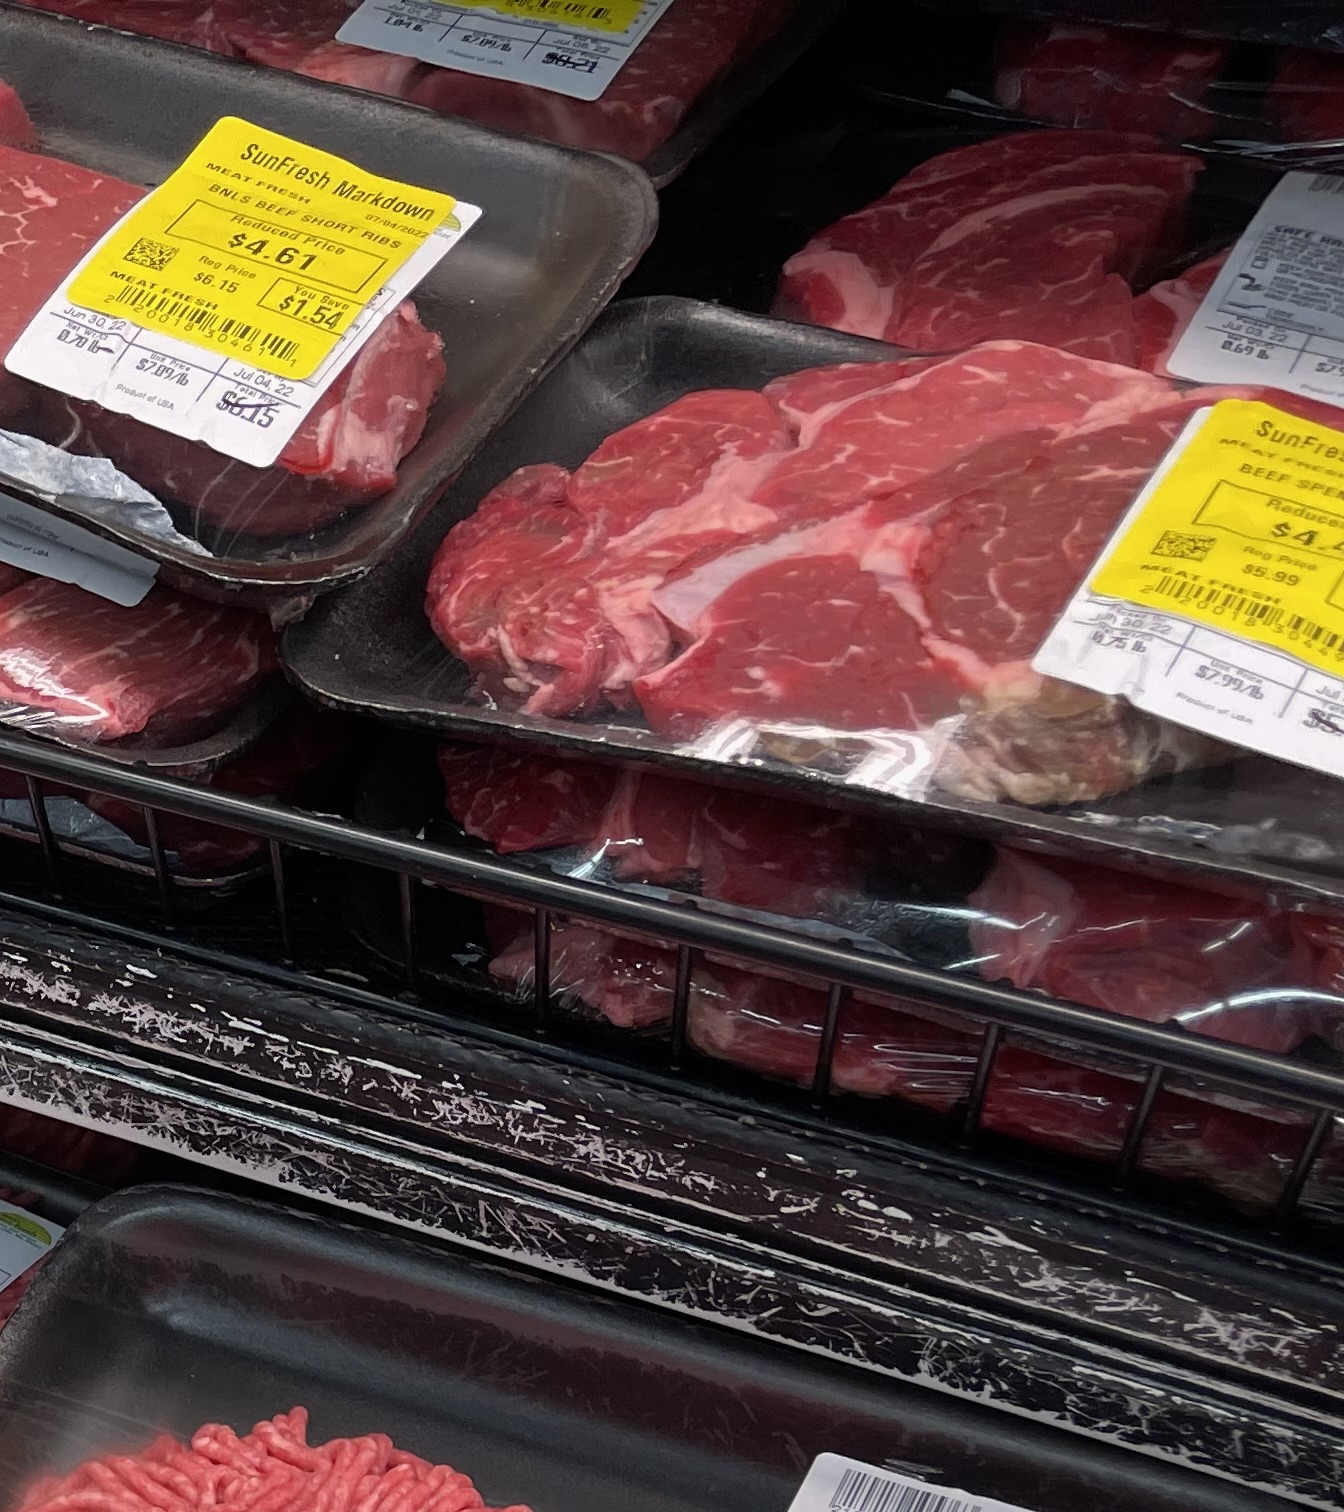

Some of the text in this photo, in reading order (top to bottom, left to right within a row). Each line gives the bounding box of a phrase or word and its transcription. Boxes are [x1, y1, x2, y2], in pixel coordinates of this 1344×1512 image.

[205, 162, 311, 205] MEAT FRESH
[240, 142, 436, 222] SunFresh Markdown
[207, 183, 403, 250] BNLS BEEF SHORT RIBS
[364, 213, 429, 239] 07/04/2022
[230, 212, 346, 256] Reduced Price
[1275, 226, 1316, 239] SAFE
[227, 231, 318, 272] $4.61
[198, 254, 257, 279] Reg Price
[109, 270, 219, 310] MEAT FRESH
[193, 271, 241, 295] $6.15
[293, 284, 351, 311] You Save
[63, 306, 85, 321] Jun
[278, 294, 345, 328] $1.54
[233, 367, 296, 397] Jul 22
[115, 383, 175, 411] Product USA
[215, 390, 280, 429] $6.15
[1219, 437, 1278, 459] MEAT
[1238, 463, 1291, 482] BEEF
[1242, 545, 1318, 571] Reg Price
[1139, 564, 1282, 604] MEAT FRESH
[1242, 563, 1300, 587] $5.99
[1194, 664, 1264, 701] $7.99/lb
